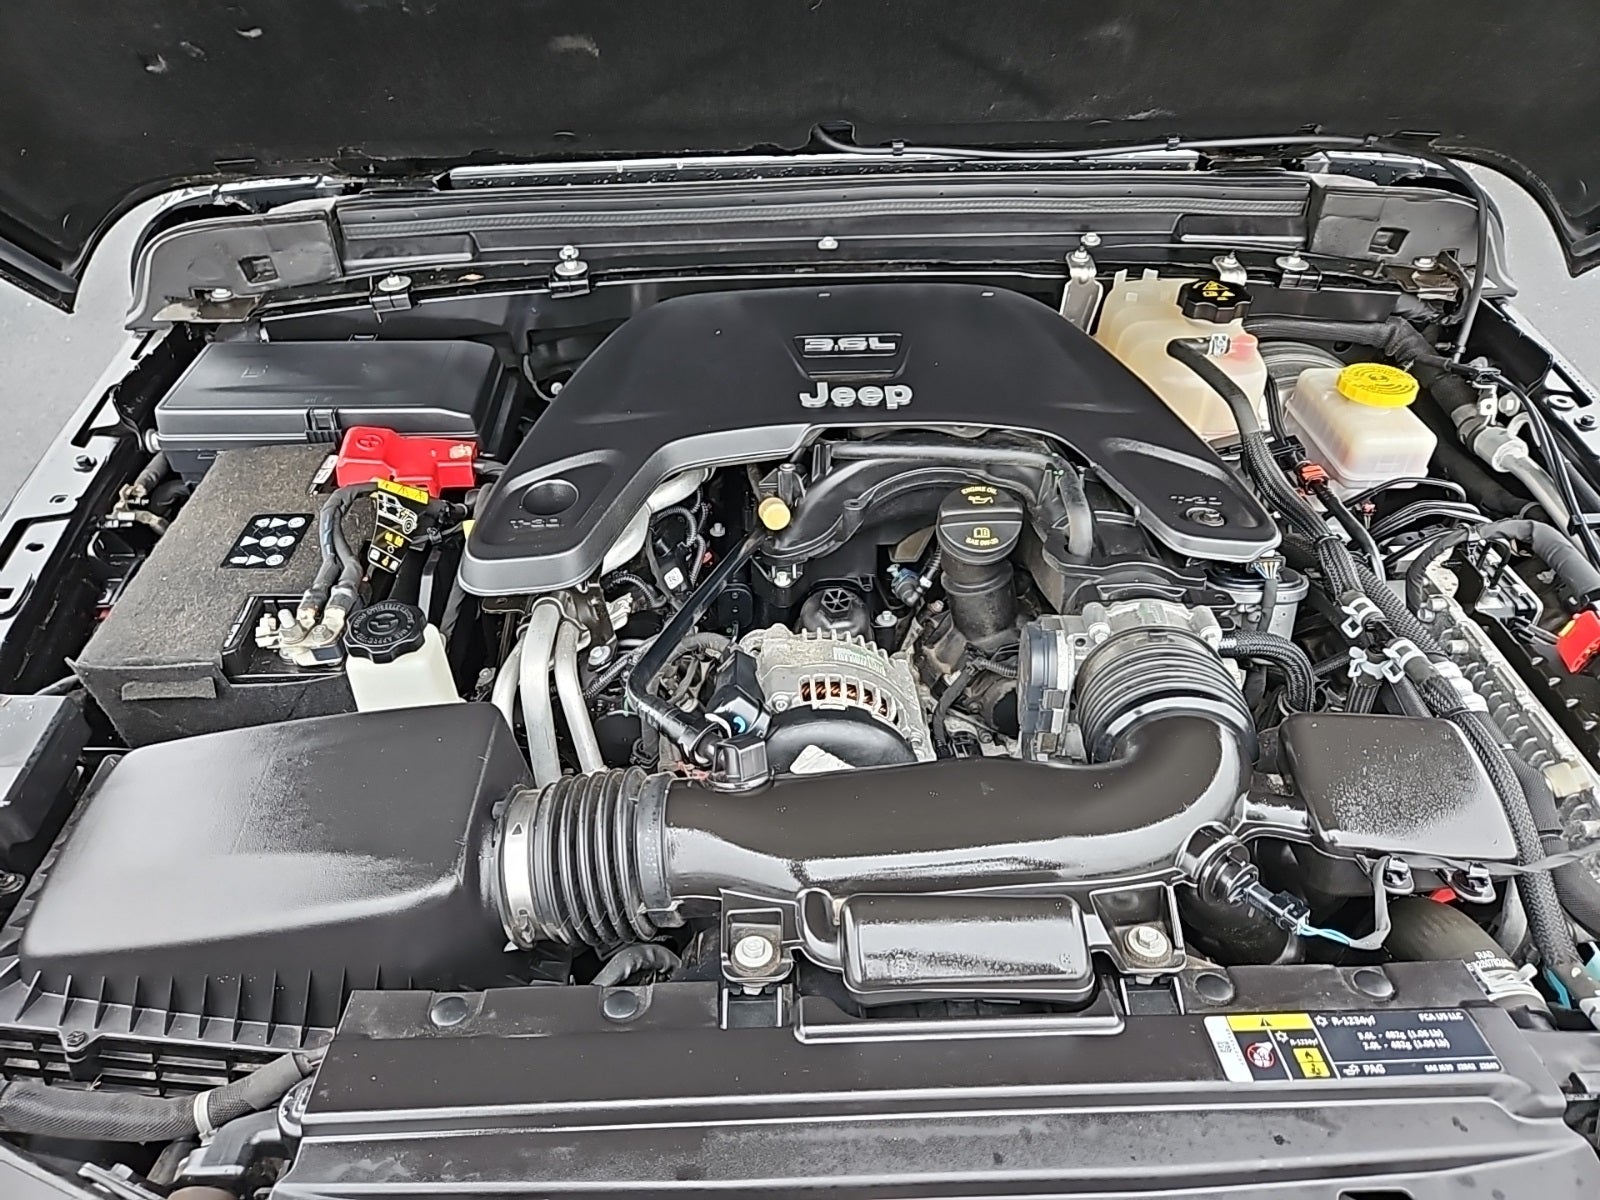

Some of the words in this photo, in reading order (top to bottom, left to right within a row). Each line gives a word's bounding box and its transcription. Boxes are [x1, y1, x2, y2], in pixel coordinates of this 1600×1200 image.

[799, 382, 913, 409] Jeep
[961, 486, 987, 495] ENGINE
[986, 487, 998, 495] OIL
[965, 537, 980, 546] SAE
[1474, 950, 1496, 960] RAD
[1331, 1015, 1376, 1027] R-1234yf
[1418, 1012, 1436, 1022] FCA
[1435, 1012, 1448, 1021] US
[1447, 1012, 1464, 1020] LLC
[1289, 1038, 1318, 1047] R-1234yf
[1362, 1064, 1386, 1075] PAG
